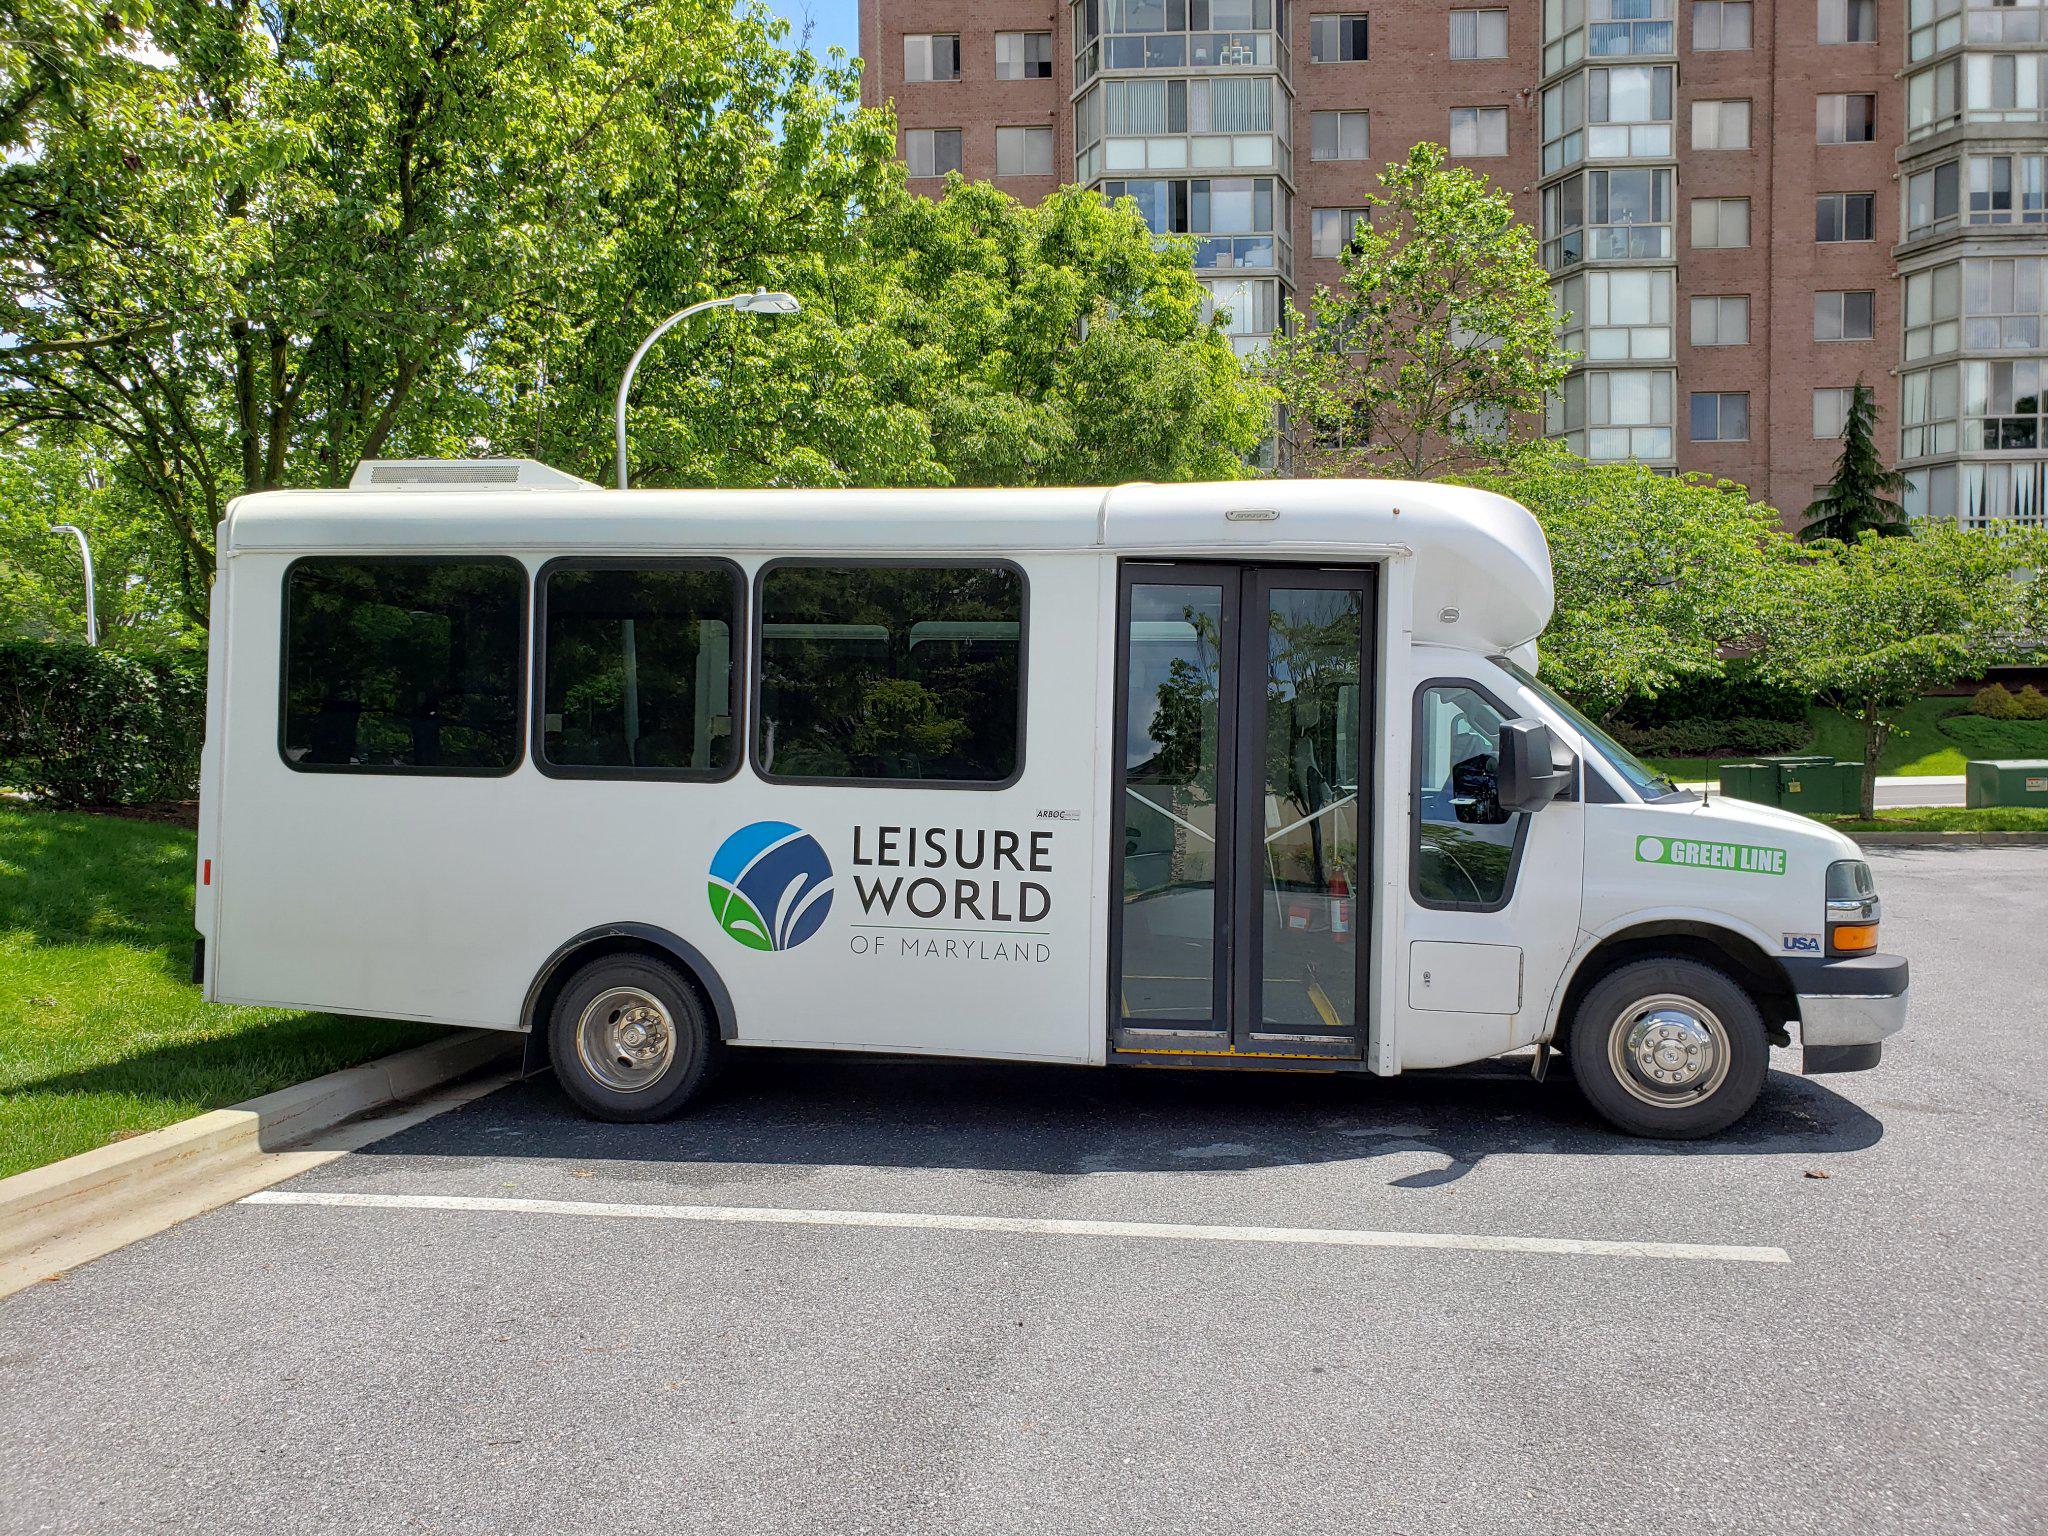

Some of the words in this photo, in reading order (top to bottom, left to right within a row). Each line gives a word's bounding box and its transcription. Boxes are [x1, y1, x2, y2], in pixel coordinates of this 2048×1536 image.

[1036, 810, 1066, 819] ARBOC
[852, 825, 1054, 873] LEISURE
[1671, 841, 1735, 868] GREEN
[1740, 848, 1783, 872] LINE
[852, 875, 1052, 923] WORLD
[850, 935, 886, 955] OF
[901, 937, 1051, 963] MARYLAND
[1783, 936, 1820, 951] USA
